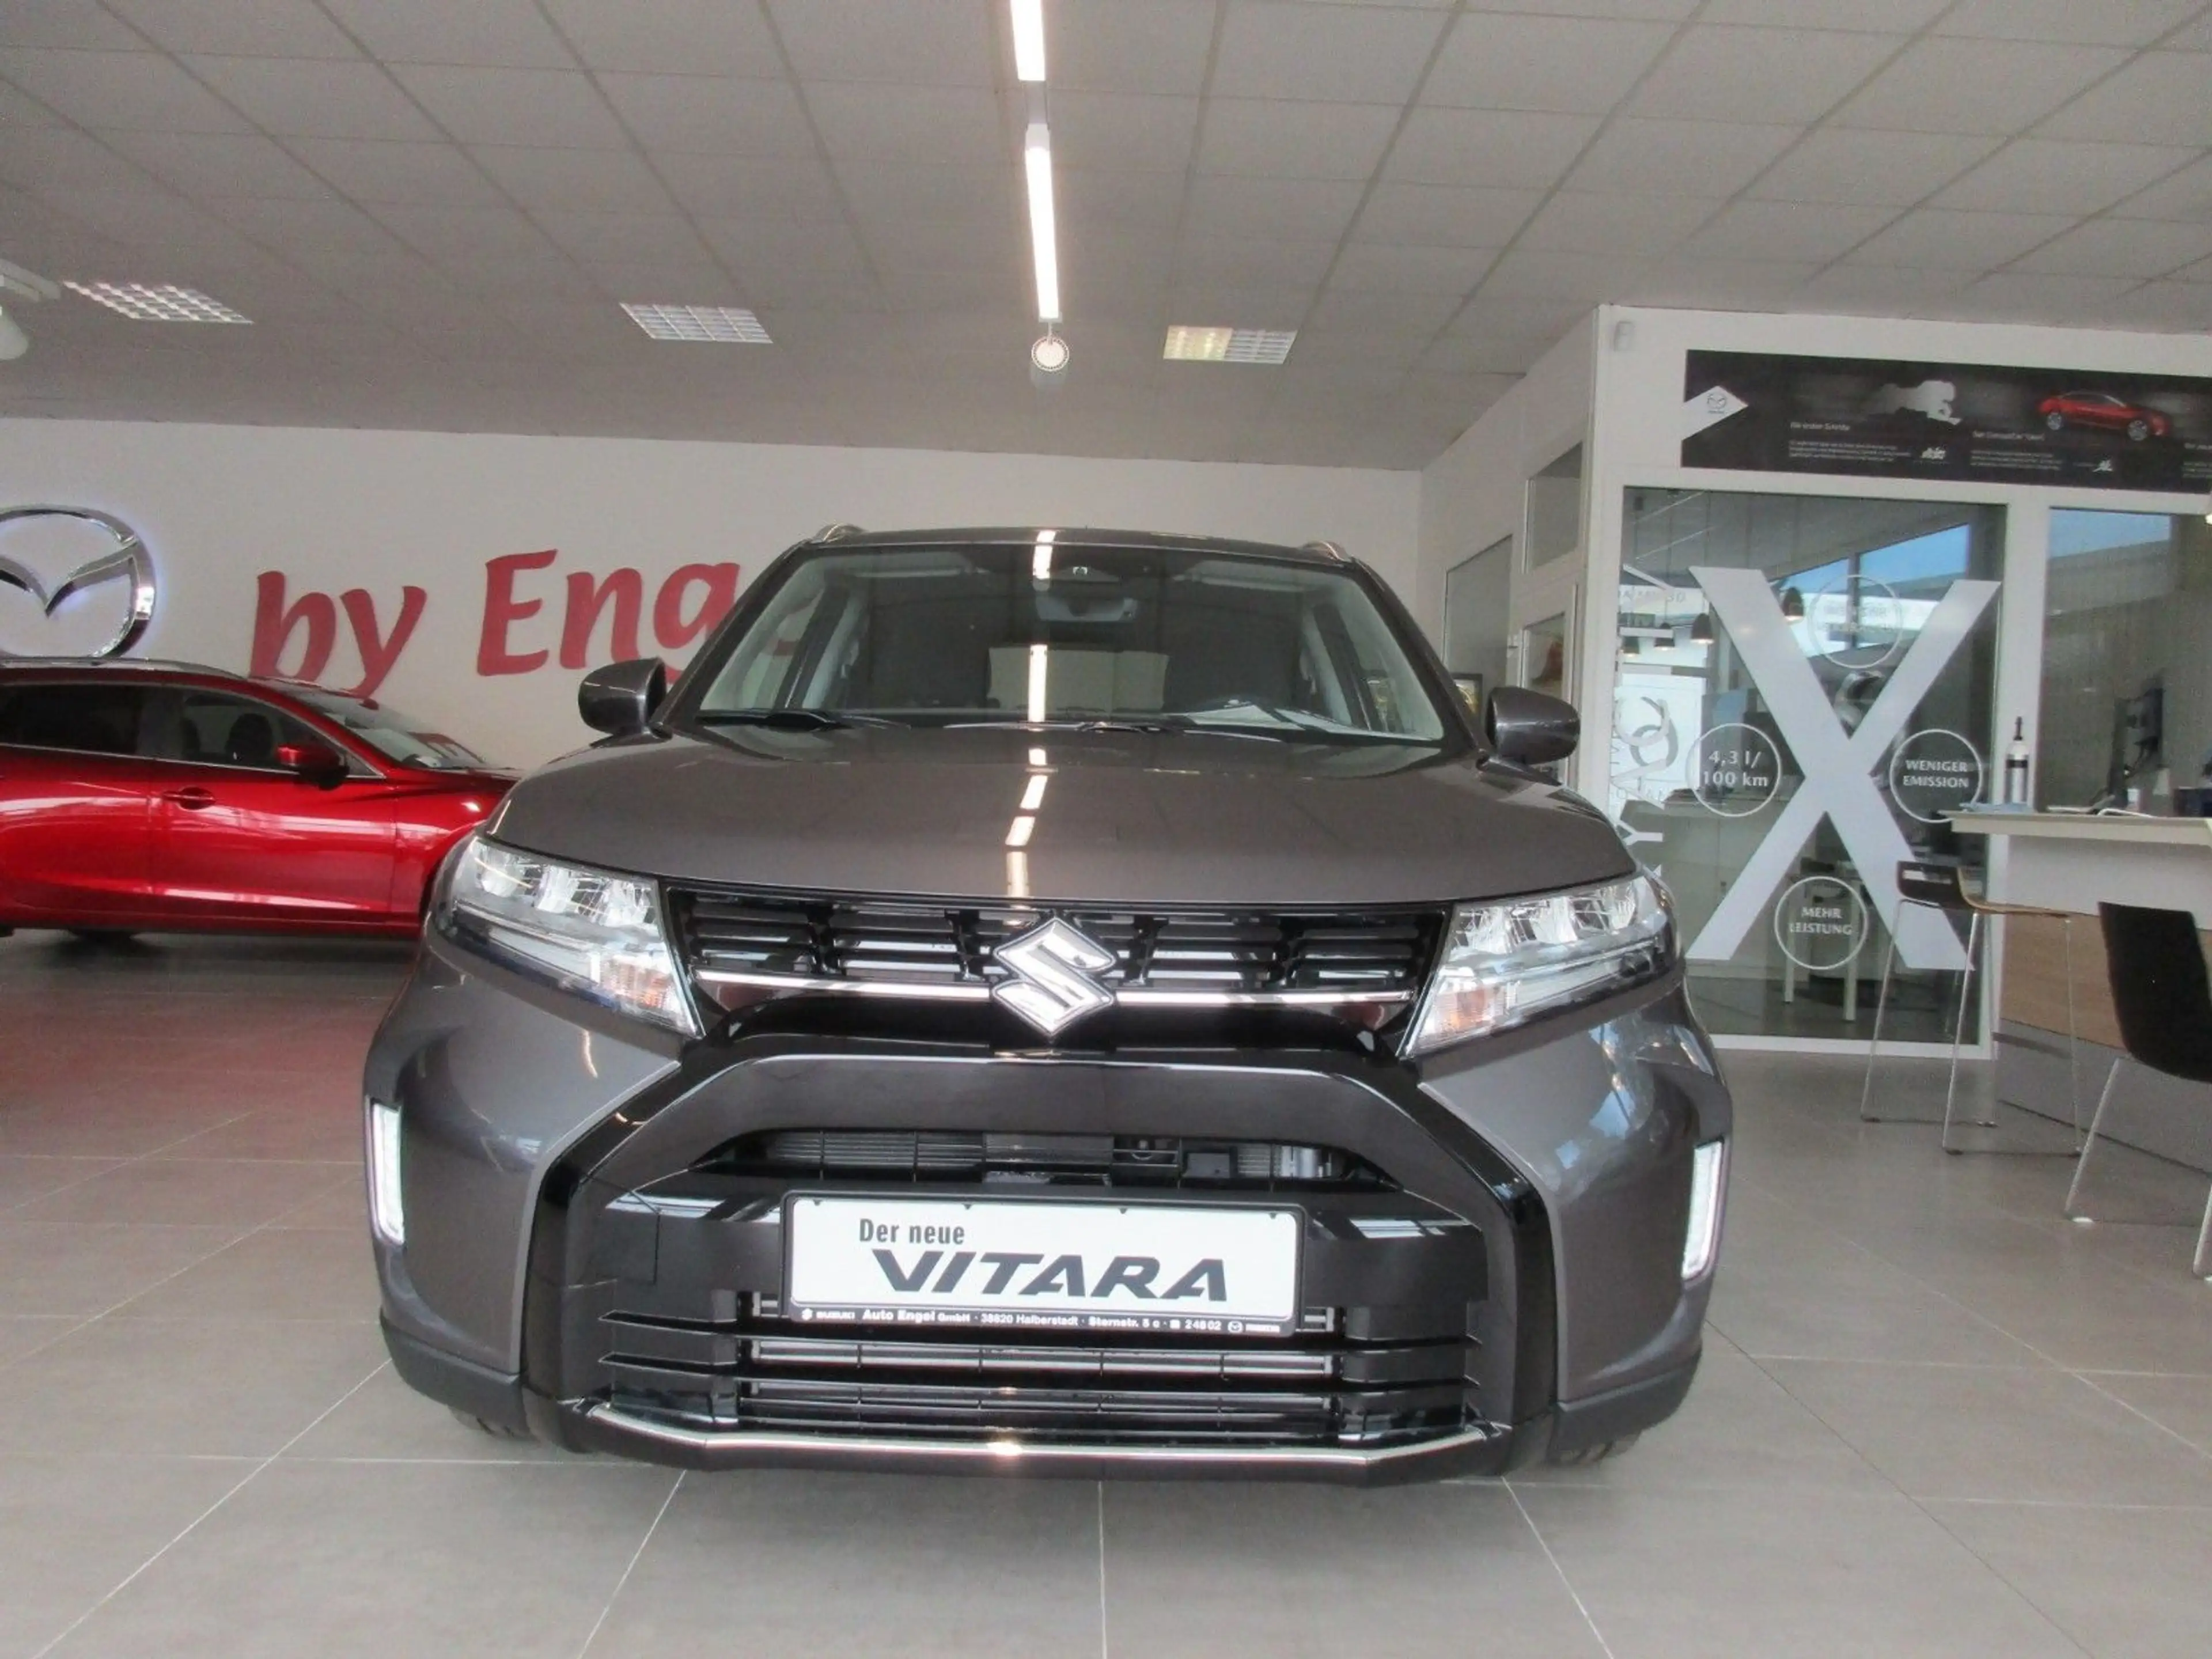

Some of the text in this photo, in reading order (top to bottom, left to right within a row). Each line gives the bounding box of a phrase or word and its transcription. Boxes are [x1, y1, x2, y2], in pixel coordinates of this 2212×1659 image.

[249, 549, 740, 699] by Eng
[1709, 750, 1738, 767] 4,3
[1906, 760, 1968, 772] WENIGER
[1703, 771, 1768, 787] 100 km
[1903, 775, 1969, 788] EMISSION
[1801, 906, 1843, 919] MEHR
[1790, 922, 1853, 935] LEISTUNG
[859, 1218, 965, 1245] Der neue
[872, 1249, 1227, 1301] VITARA
[862, 1309, 893, 1320] Auto
[897, 1309, 935, 1323] Engel
[1016, 1315, 1079, 1326] Halberstadt
